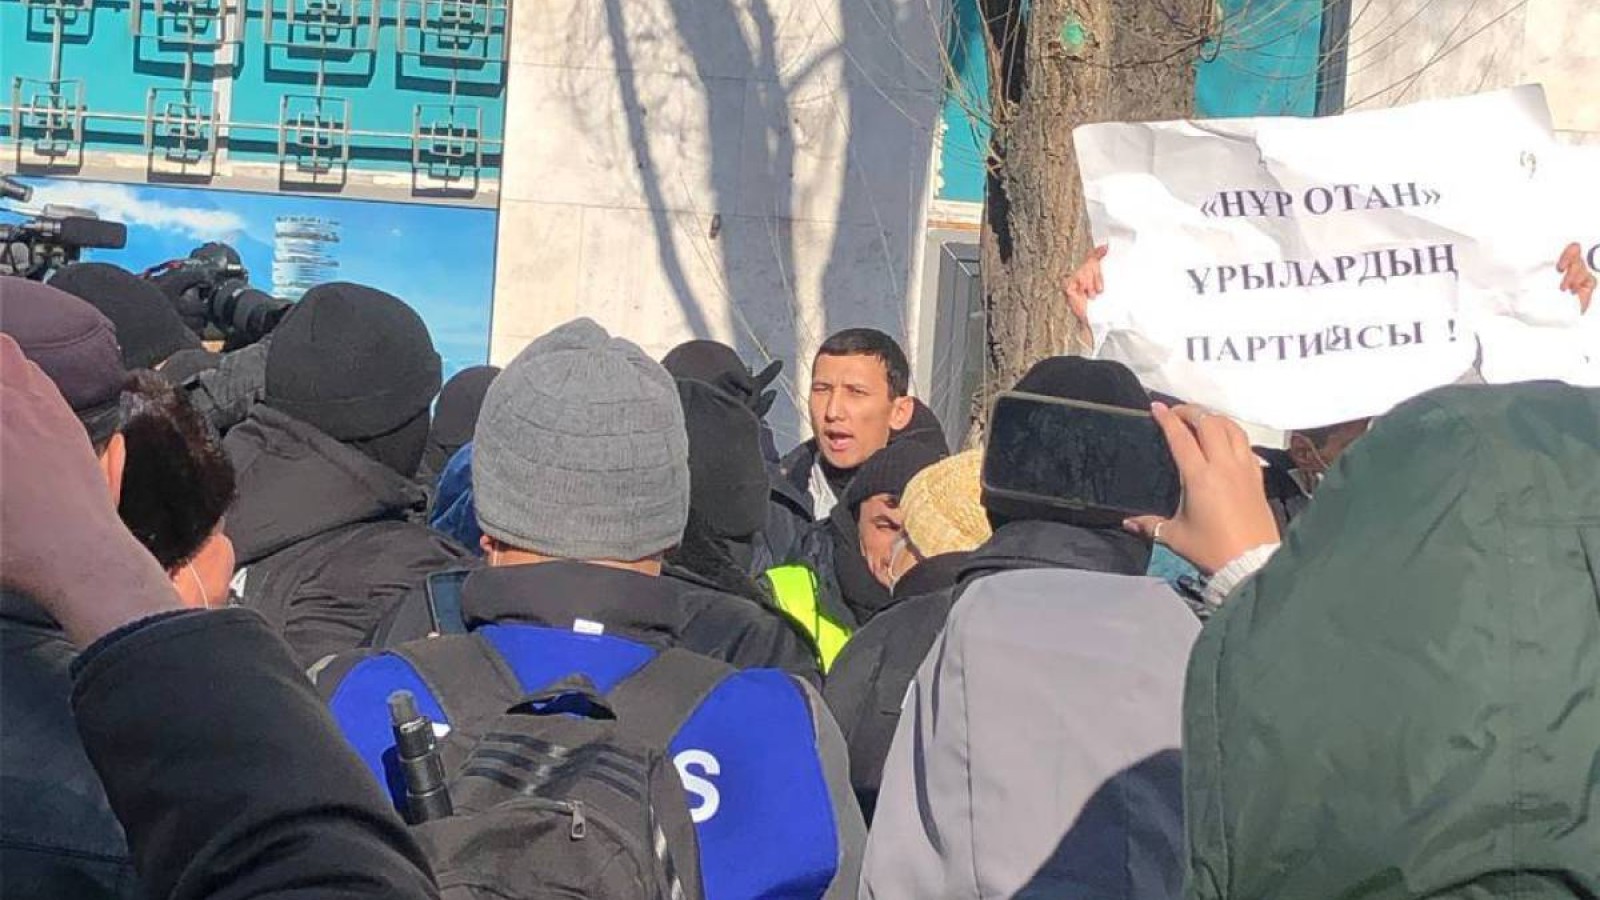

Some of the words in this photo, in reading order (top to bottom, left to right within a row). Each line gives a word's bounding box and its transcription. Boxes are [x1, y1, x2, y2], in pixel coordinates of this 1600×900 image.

[1200, 190, 1293, 217] «НҰР
[1304, 182, 1441, 215] ОТАН»
[1186, 244, 1458, 294] ҰРЫЛАРДЫҢ
